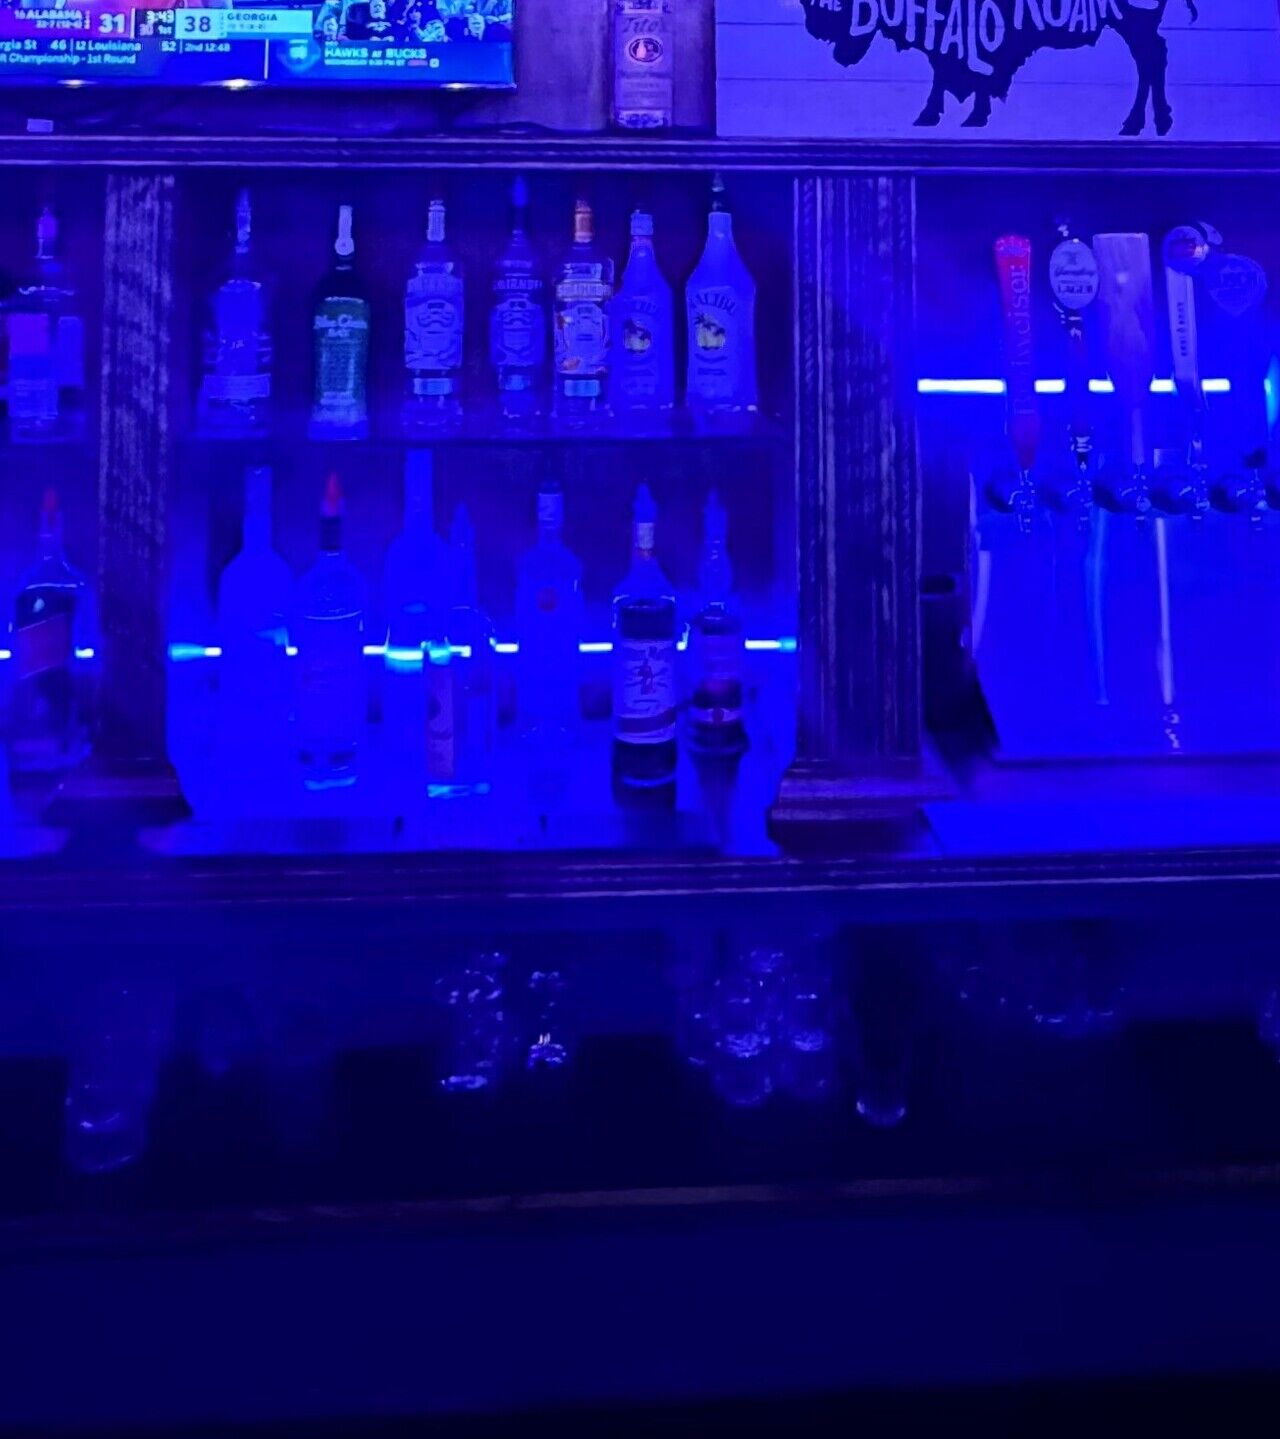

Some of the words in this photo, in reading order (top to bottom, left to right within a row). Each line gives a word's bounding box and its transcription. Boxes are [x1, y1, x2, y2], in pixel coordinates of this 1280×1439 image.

[99, 13, 125, 33] 31
[227, 13, 278, 22] GEORGIA
[184, 16, 211, 33] 38
[24, 39, 37, 50] St
[88, 40, 142, 51] Louisiana
[9, 52, 80, 65] Championship
[103, 53, 136, 64] Round
[324, 48, 368, 58] HAWKS
